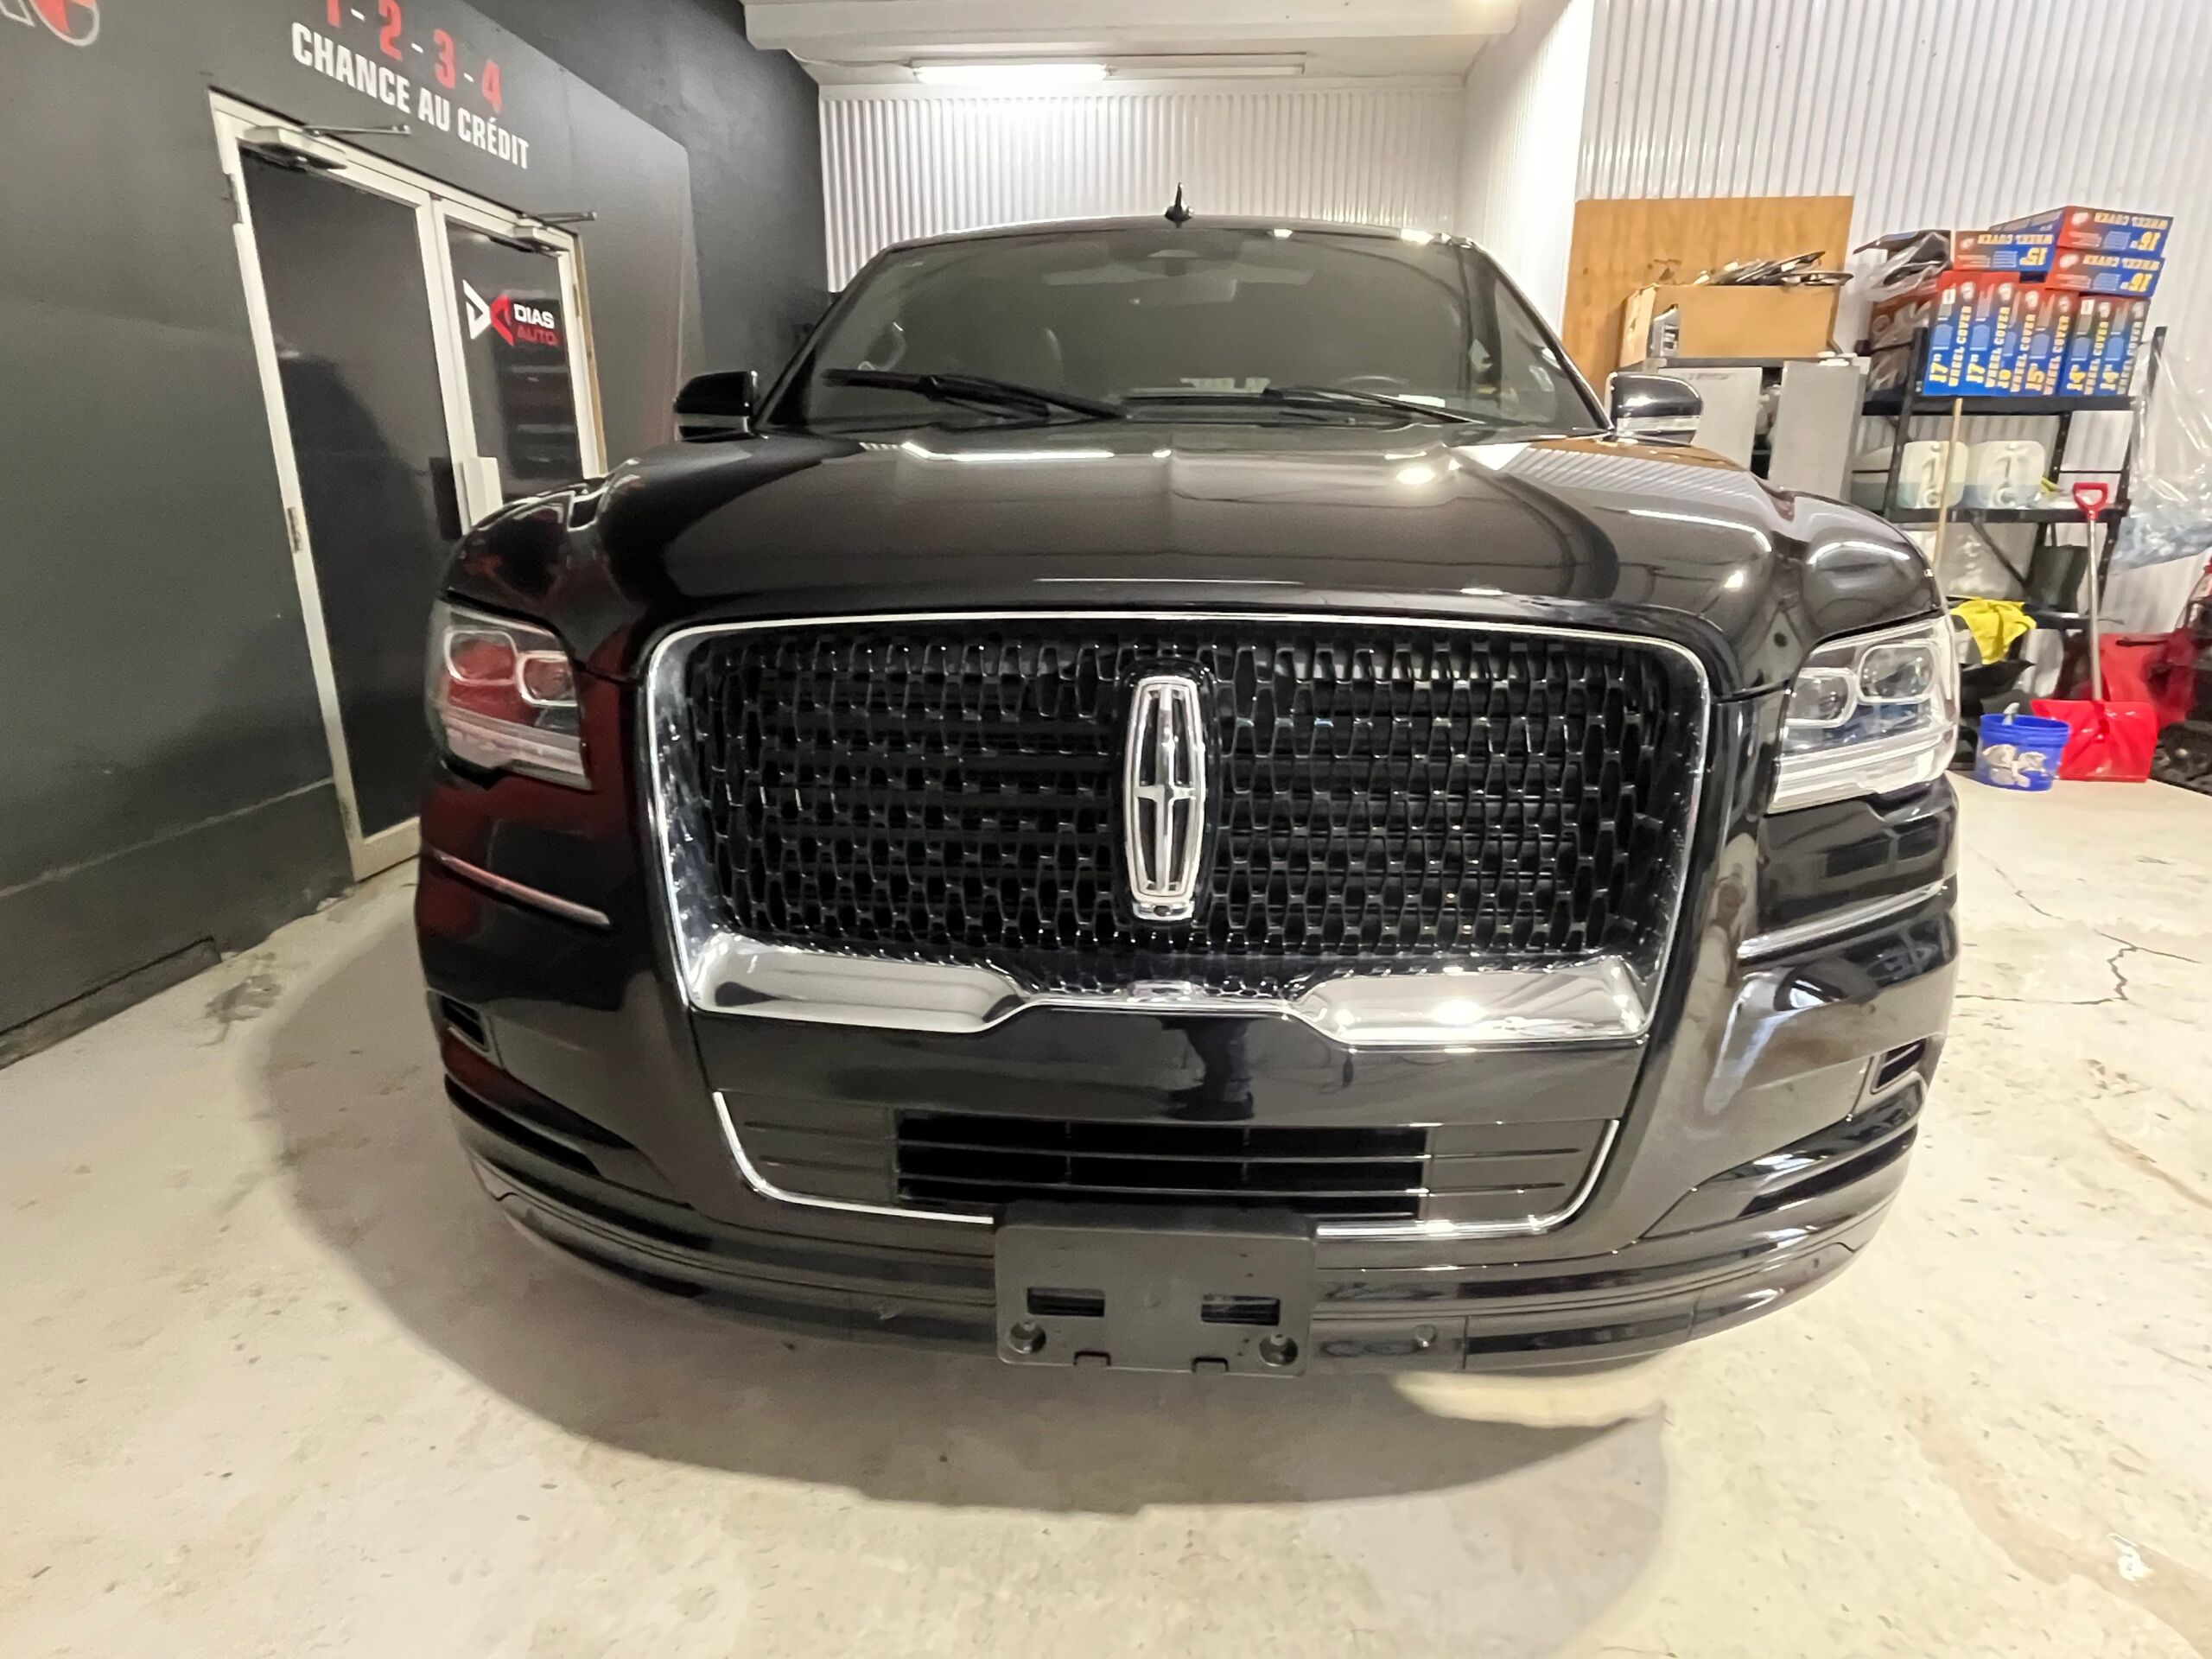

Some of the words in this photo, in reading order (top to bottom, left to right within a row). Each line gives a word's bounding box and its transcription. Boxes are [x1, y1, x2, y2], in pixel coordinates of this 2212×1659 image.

[292, 22, 411, 114] CHANCE
[417, 86, 450, 131] AU
[457, 107, 529, 169] CRÉDIT
[513, 303, 555, 329] DIAS
[518, 326, 558, 346] AUTO
[1956, 306, 1972, 344] COVER
[1993, 307, 2011, 346] COVER
[2052, 315, 2070, 353] COVER
[1948, 346, 1965, 387] WHEEL
[1985, 347, 2002, 388] WHEEL
[2010, 353, 2028, 392] WHEEL
[2019, 314, 2037, 351] COVER
[2083, 358, 2101, 395] WHEEL
[2093, 321, 2109, 356] COVER
[2043, 355, 2062, 396] WHEEL
